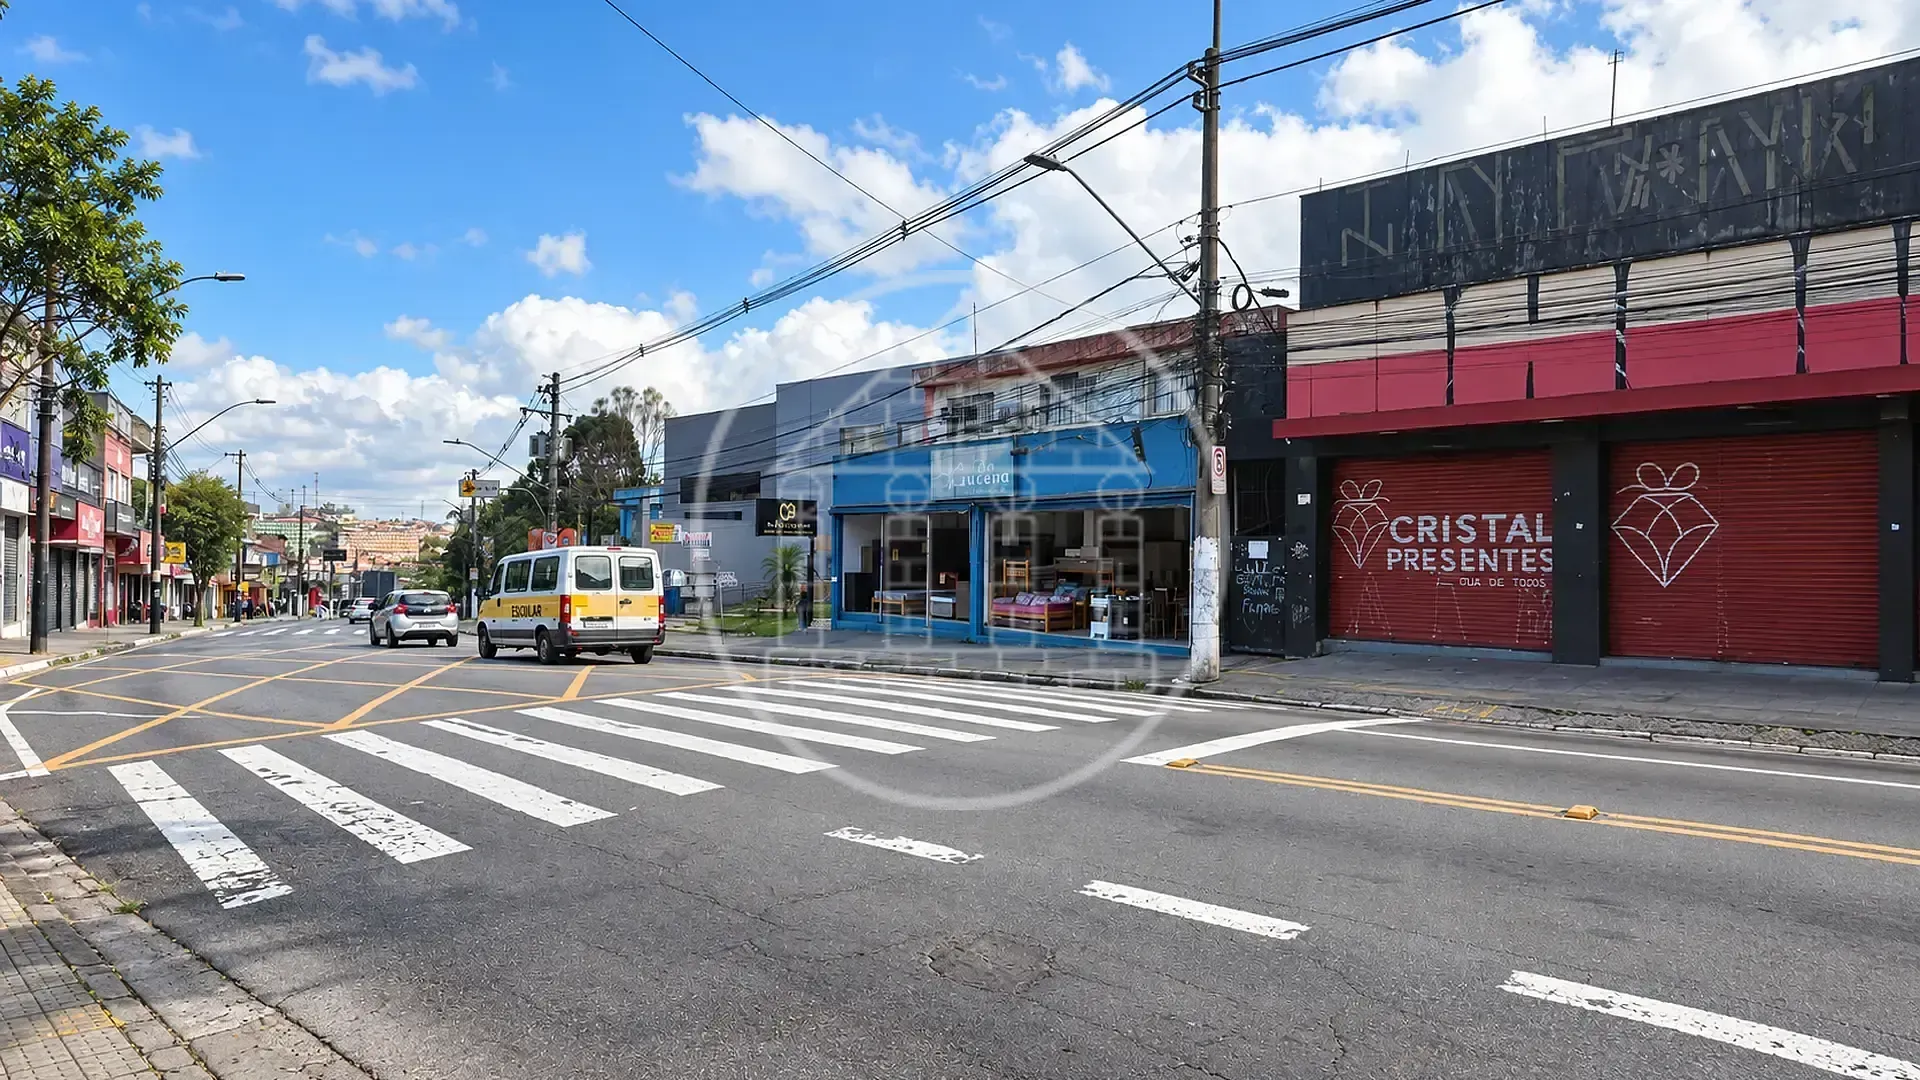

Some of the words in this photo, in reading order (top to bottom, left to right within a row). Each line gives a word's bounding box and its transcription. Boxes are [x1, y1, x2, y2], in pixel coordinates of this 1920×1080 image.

[1389, 513, 1553, 544] CRISTAL
[1386, 548, 1553, 572] PRESENTES
[1489, 578, 1505, 587] DE
